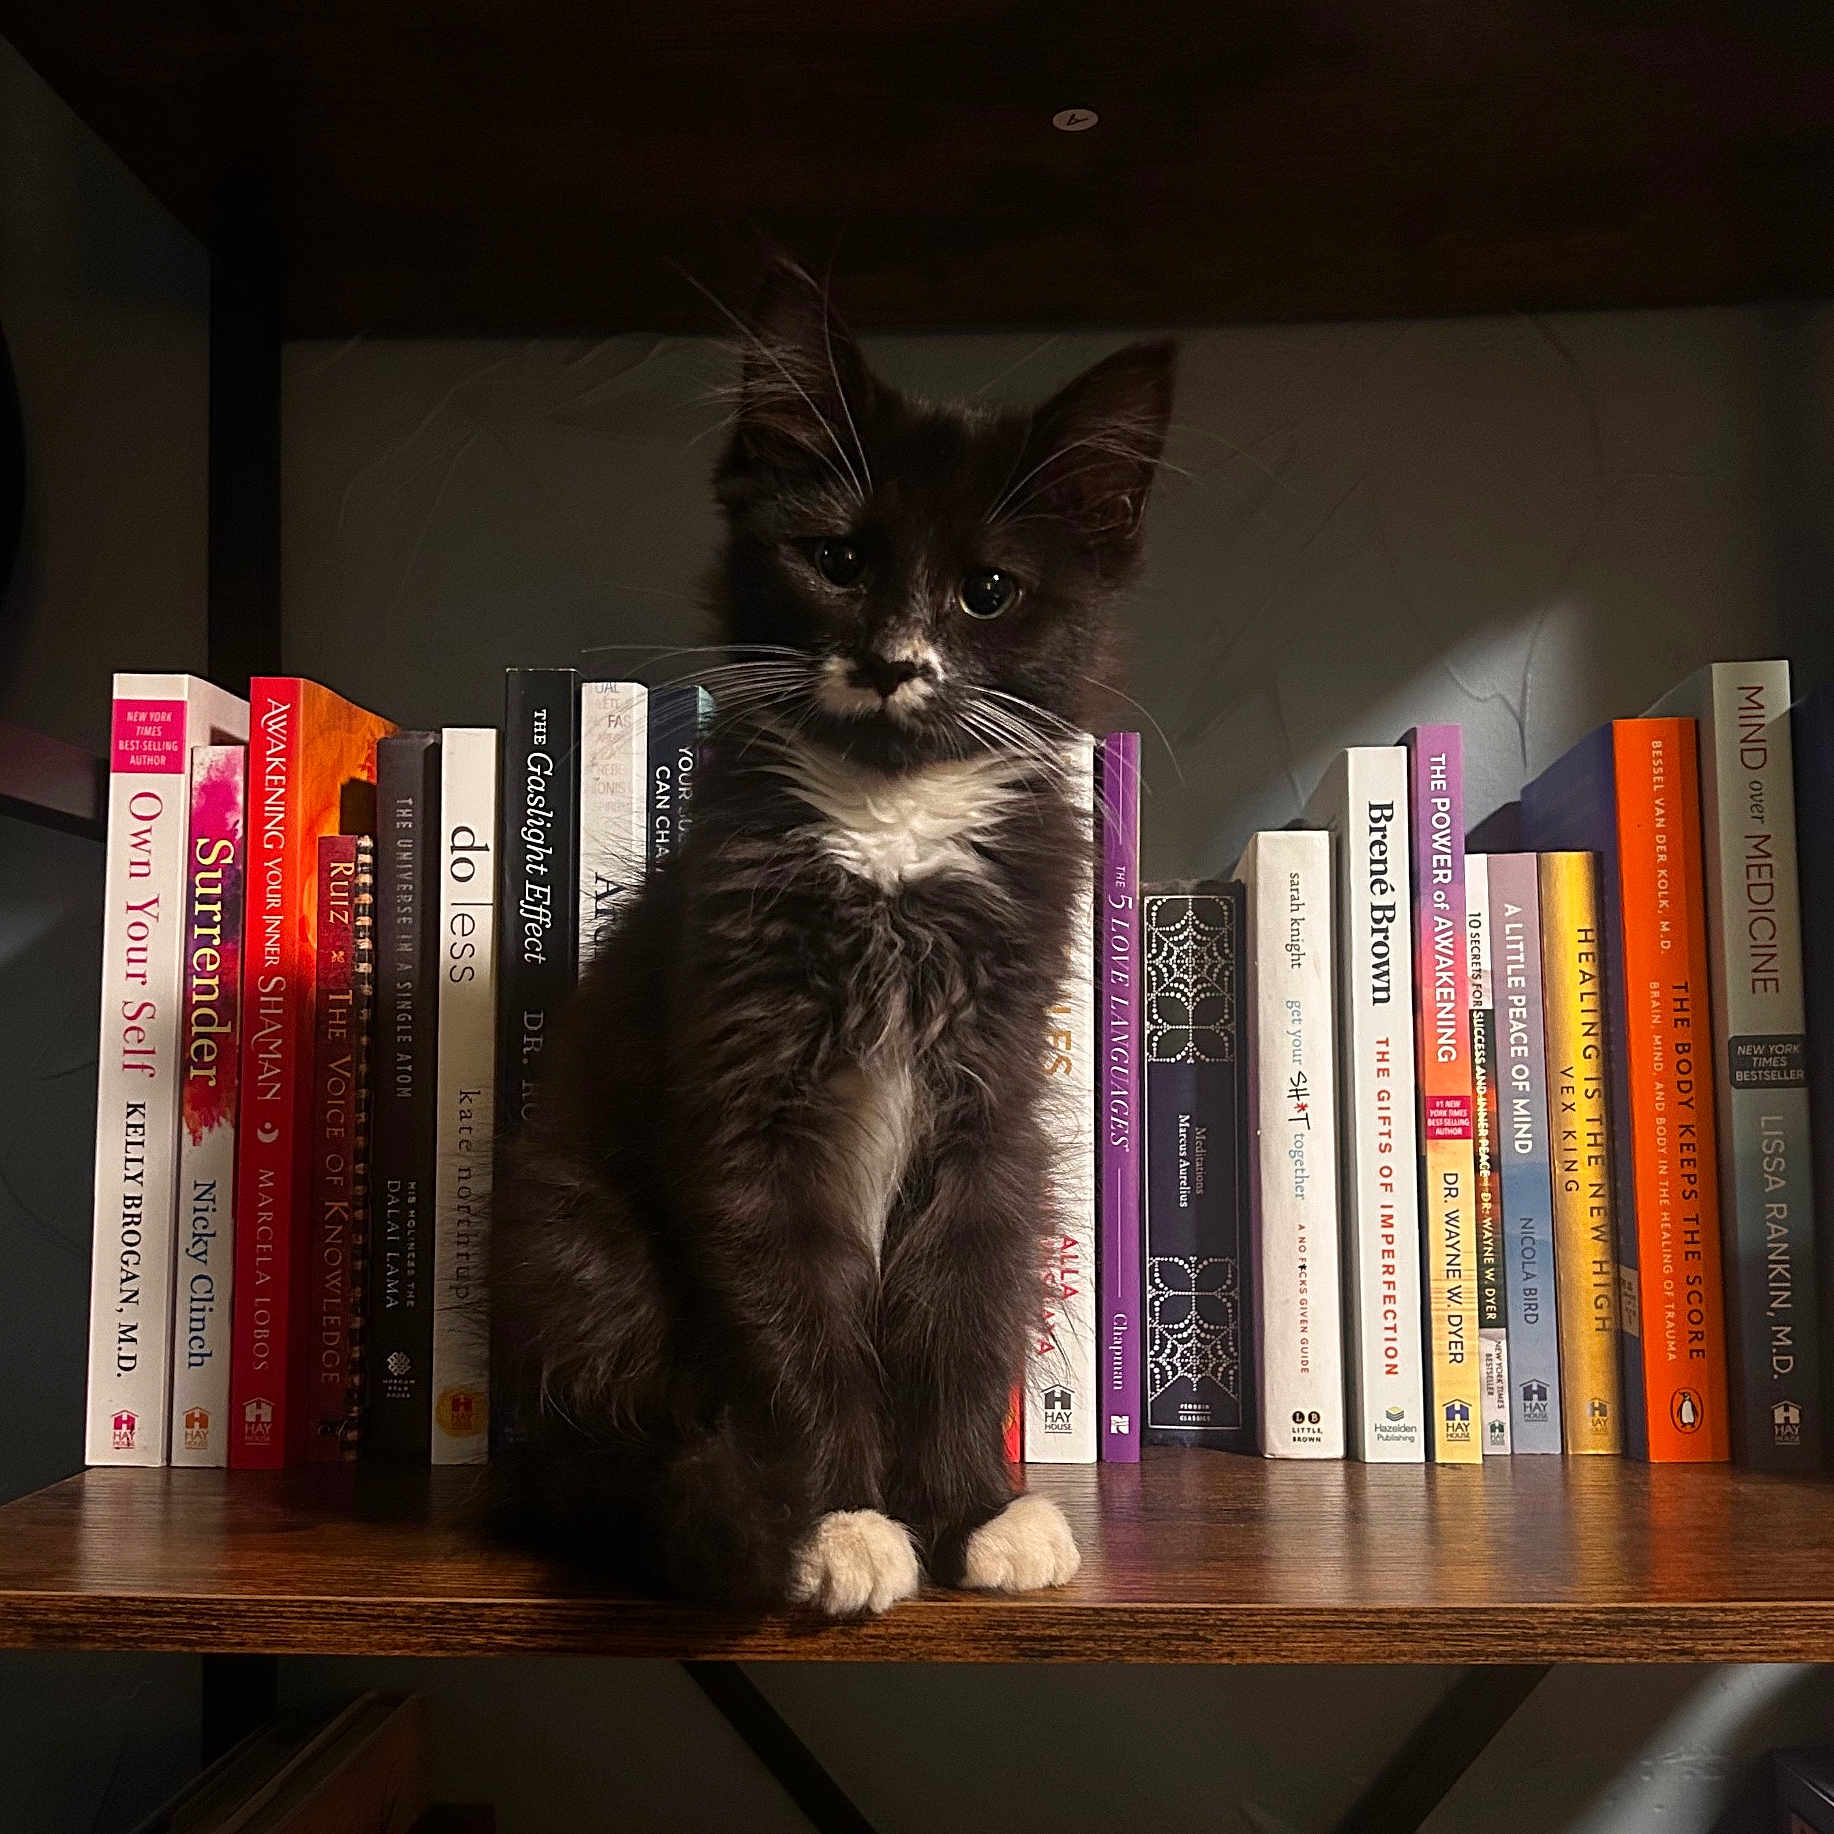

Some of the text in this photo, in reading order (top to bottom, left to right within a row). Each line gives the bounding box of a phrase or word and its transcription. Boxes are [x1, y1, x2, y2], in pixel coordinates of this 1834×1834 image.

[126, 711, 172, 722] NEW YORK
[136, 726, 162, 736] TIMES
[119, 740, 178, 752] BEST-SELLING
[130, 754, 166, 766] AUTHOR
[656, 766, 670, 809] CAN
[678, 746, 694, 801] YOUR
[520, 709, 554, 965] THE Gaslight Effect
[1652, 740, 1671, 954] BESSEL VAN DER KOLK, M.D.
[1736, 686, 1779, 995] MIND over MEDICINE
[250, 698, 290, 1101] AWAKENING YOUR INNER SHAMAN
[329, 861, 354, 923] RUIZ
[1109, 894, 1132, 910] 5
[1116, 866, 1126, 887] THE
[1368, 800, 1397, 1006] Brené Brown
[449, 826, 493, 984] do less
[1285, 872, 1305, 968] sarah knight
[1429, 753, 1457, 1063] THE POWER of AWAKENING
[1469, 913, 1482, 928] 10
[121, 791, 163, 1079] Own Your Self
[395, 798, 413, 1098] THE UNIVERSE IN A SINGLE ATOM
[1110, 918, 1131, 987] LOVE
[1471, 932, 1482, 980] SECRETS
[189, 838, 234, 1087] Surrender
[1286, 1001, 1302, 1024] get
[1472, 983, 1483, 1008] FOR
[523, 1010, 545, 1065] DR.
[1287, 1030, 1302, 1065] your
[1472, 1010, 1487, 1064] SUCCESS
[1504, 903, 1533, 1155] A LITTLE PEACE OF MIND
[1737, 1043, 1800, 1056] NEW YORK
[1475, 1065, 1489, 1094] AND
[1736, 1070, 1804, 1082] BESTSELLER
[1752, 1056, 1787, 1067] TIMES
[459, 1090, 480, 1152] kate
[1445, 1100, 1461, 1108] NEW
[1559, 1065, 1579, 1193] VEX KING
[1577, 927, 1611, 1333] HEALING IS THE NEW HIGH
[1436, 1128, 1462, 1136] AUTHOR
[1479, 1139, 1491, 1177] PEACE
[320, 989, 353, 1385] THE VOICE OF KNOWLEDGE
[1179, 1114, 1191, 1208] Marcus Aurelius
[1195, 1127, 1208, 1194] Meditations
[1289, 1133, 1310, 1200] together
[1649, 982, 1676, 1360] BRAIN, MIND, AND BODY IN THE HEALING OF TRAUMA
[1671, 981, 1705, 1360] THE BODY KEEPS THE SCORE
[1375, 1037, 1398, 1376] THE GIFTS OF IMPERFECTION
[116, 1101, 146, 1378] KELLY BROGAN, M.D.
[386, 1180, 400, 1308] DALAI LAMA
[1299, 1237, 1306, 1253] NO
[1483, 1217, 1495, 1264] WAYNE
[1760, 1115, 1793, 1380] LISSA RANKIN, M.D.
[185, 1180, 217, 1370] Nicky Clinch
[252, 1169, 275, 1371] MARCELA LOBOS
[1061, 1234, 1079, 1301] ALLA
[1442, 1172, 1464, 1364] DR. WAYNE W. DYER
[1485, 1266, 1496, 1284] W.
[1519, 1217, 1539, 1325] NICOLA BIRD
[1300, 1298, 1308, 1334] GIVEN
[1485, 1288, 1498, 1319] DYER
[1109, 1314, 1128, 1391] Chapman
[1301, 1336, 1310, 1374] GUIDE
[1486, 1353, 1494, 1396] BESTSELLER
[1496, 1362, 1504, 1384] YORK
[244, 1423, 271, 1434] HAY
[1044, 1412, 1072, 1423] HAY
[1446, 1422, 1470, 1432] HAY
[1524, 1402, 1548, 1412] HAY
[1774, 1425, 1800, 1434] HAY
[113, 1430, 136, 1441] HAY
[185, 1430, 208, 1441] HAY
[1377, 1433, 1415, 1442] Publishing
